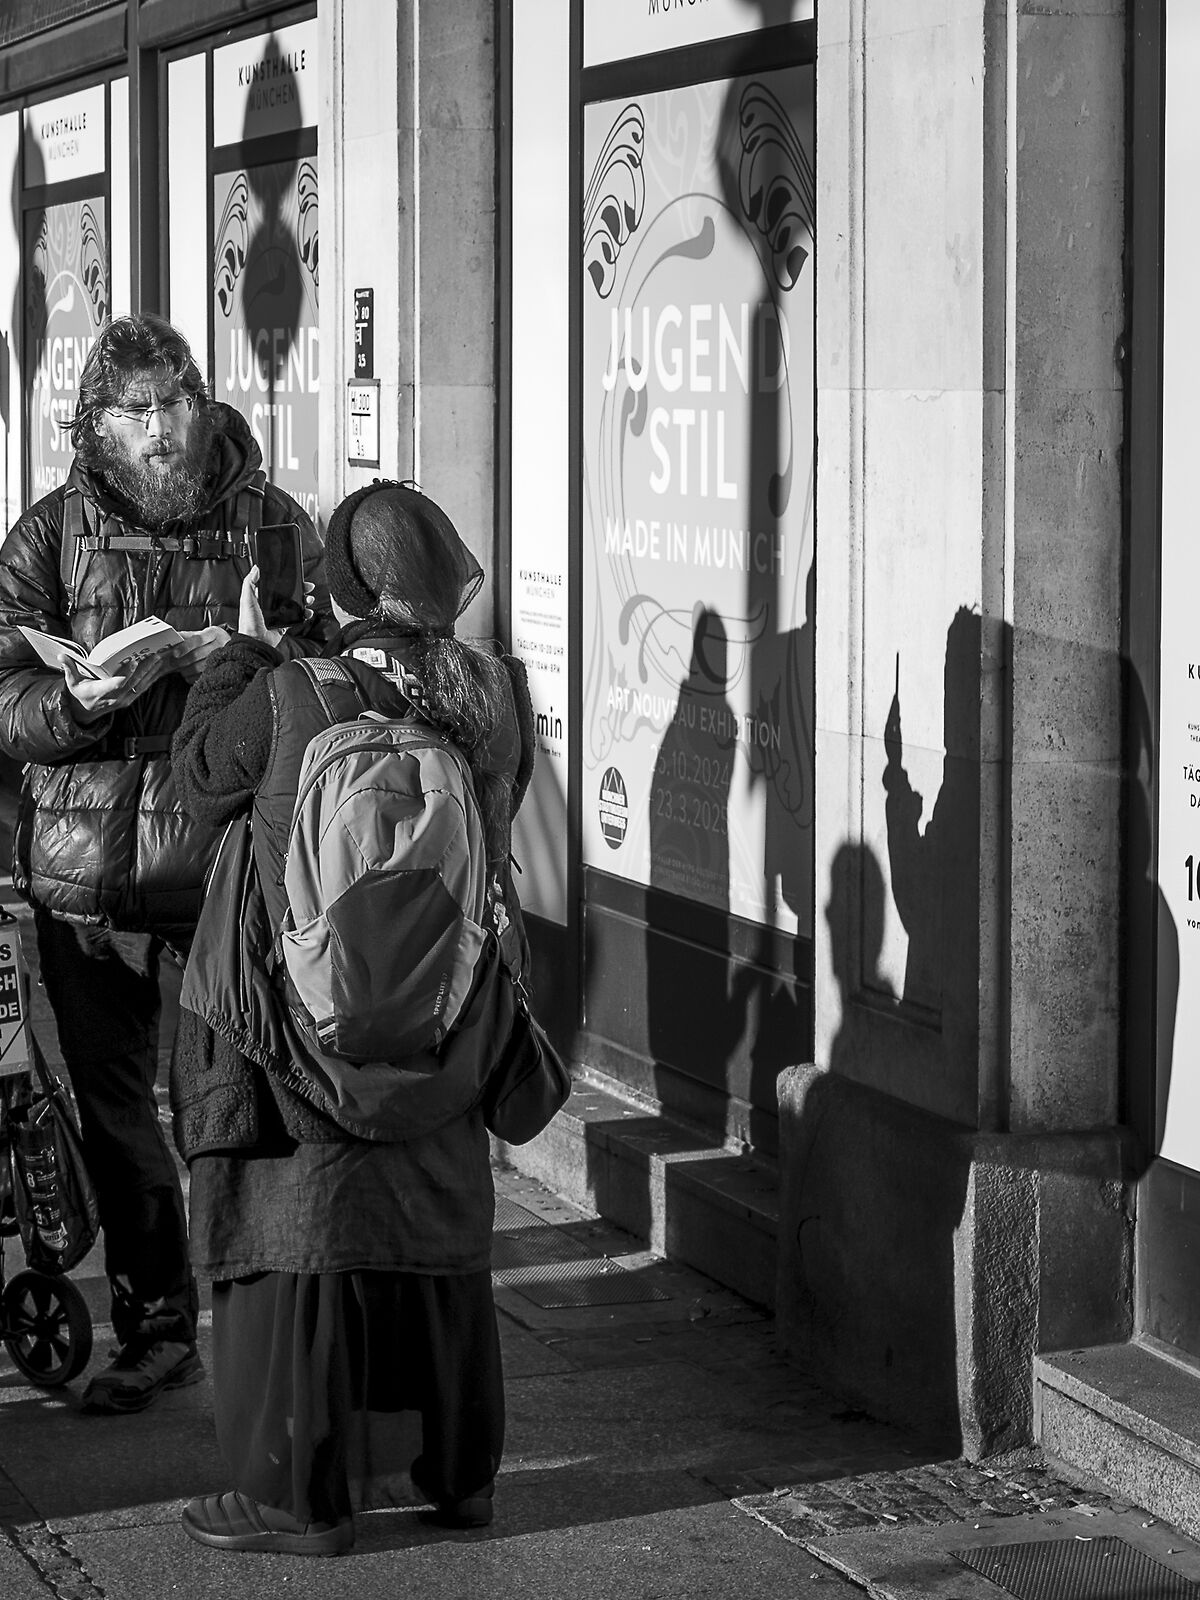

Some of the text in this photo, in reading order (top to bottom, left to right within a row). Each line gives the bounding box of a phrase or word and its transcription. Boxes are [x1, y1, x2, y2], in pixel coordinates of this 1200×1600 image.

[238, 50, 305, 87] KUNSTHALLE
[248, 83, 295, 112] MÜNCHEN
[41, 112, 87, 139] KUNSTHALLE
[225, 326, 320, 394] JUGEND
[602, 302, 791, 395] JUGEND
[251, 402, 300, 471] STIL
[649, 406, 739, 500] STIL
[604, 517, 786, 577] MADE IN MUNICH
[519, 570, 562, 586] KUNSTHALLE
[606, 684, 782, 750] ART NOUVEAU EXHIBITION
[651, 743, 730, 791] 25.10.2024
